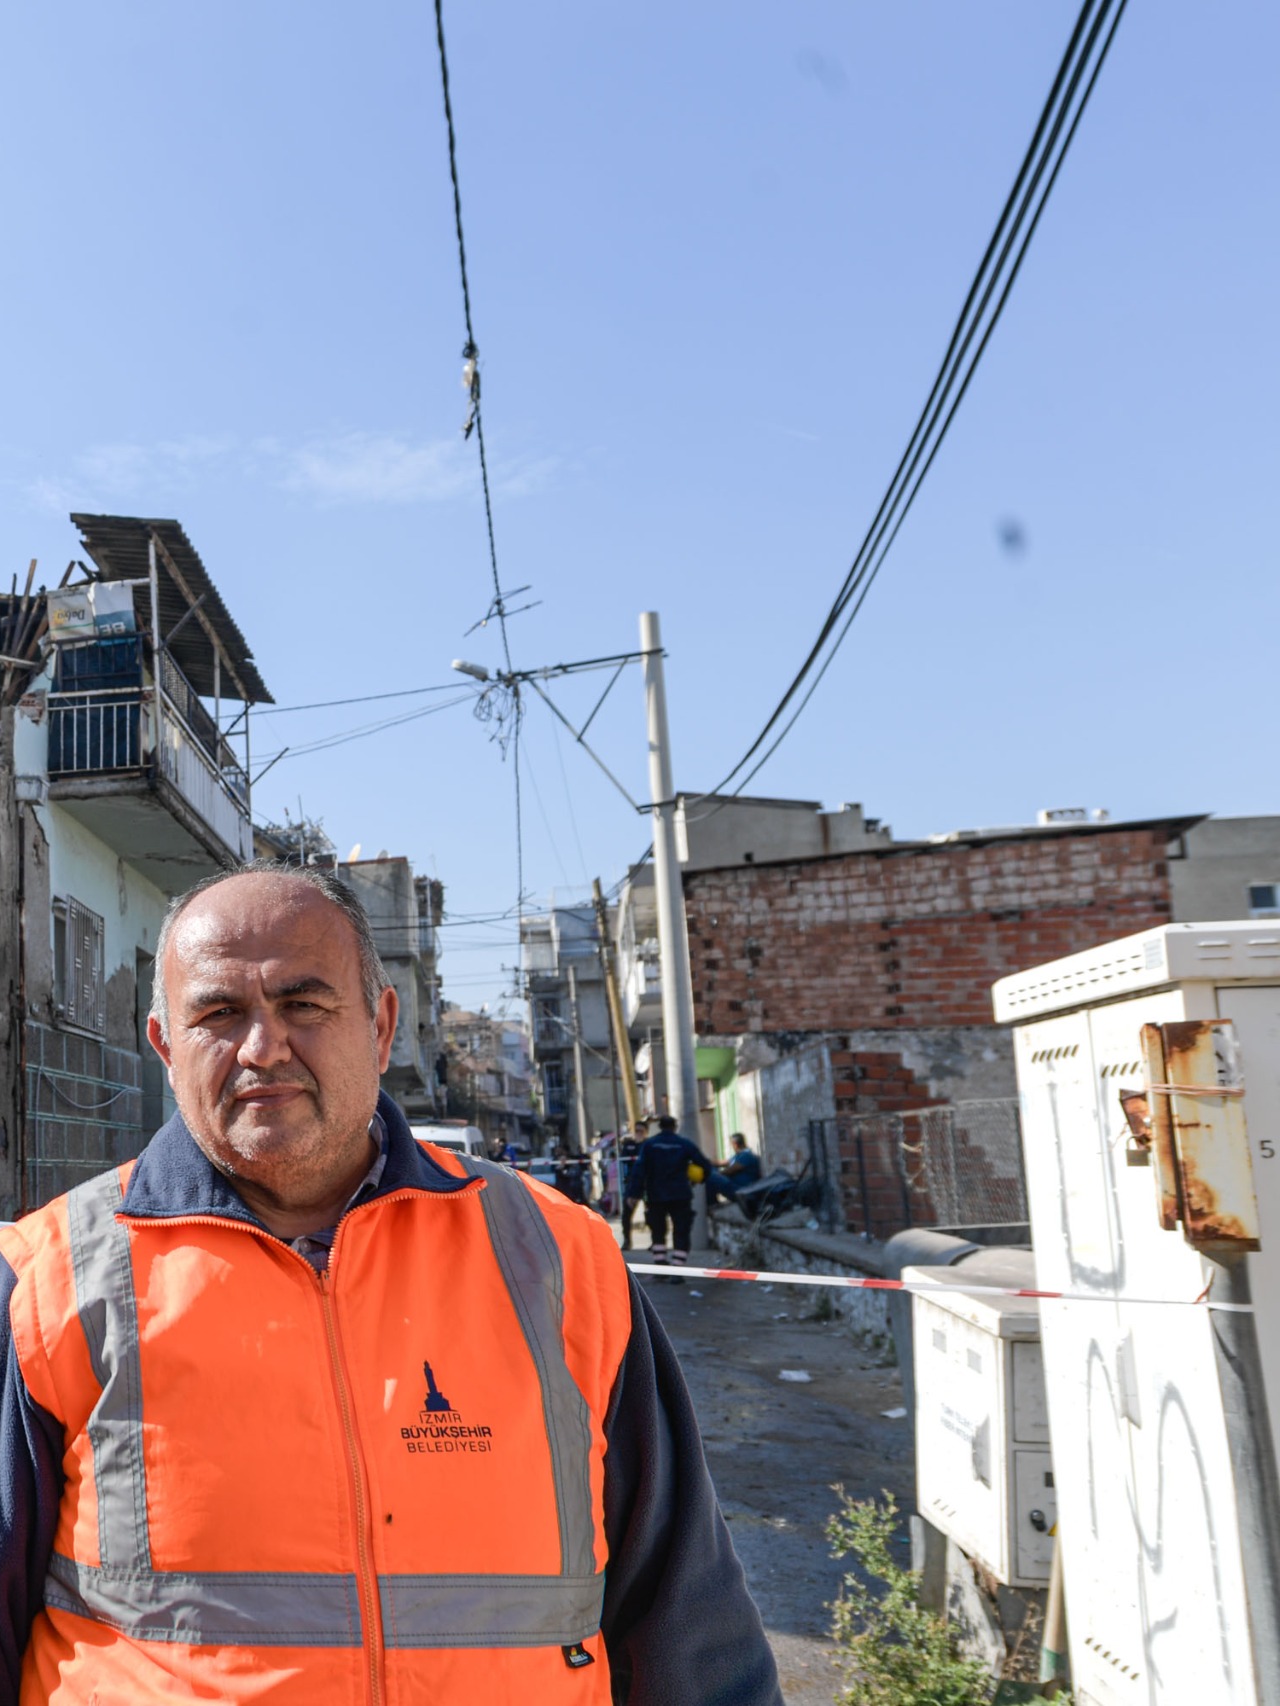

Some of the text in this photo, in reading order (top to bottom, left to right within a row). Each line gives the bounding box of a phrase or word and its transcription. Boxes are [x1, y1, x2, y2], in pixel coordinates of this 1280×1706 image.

[1258, 1139, 1276, 1159] 5
[400, 1424, 493, 1439] BÜYÜKŞEHİR
[406, 1439, 492, 1453] BELEDİYESİ
